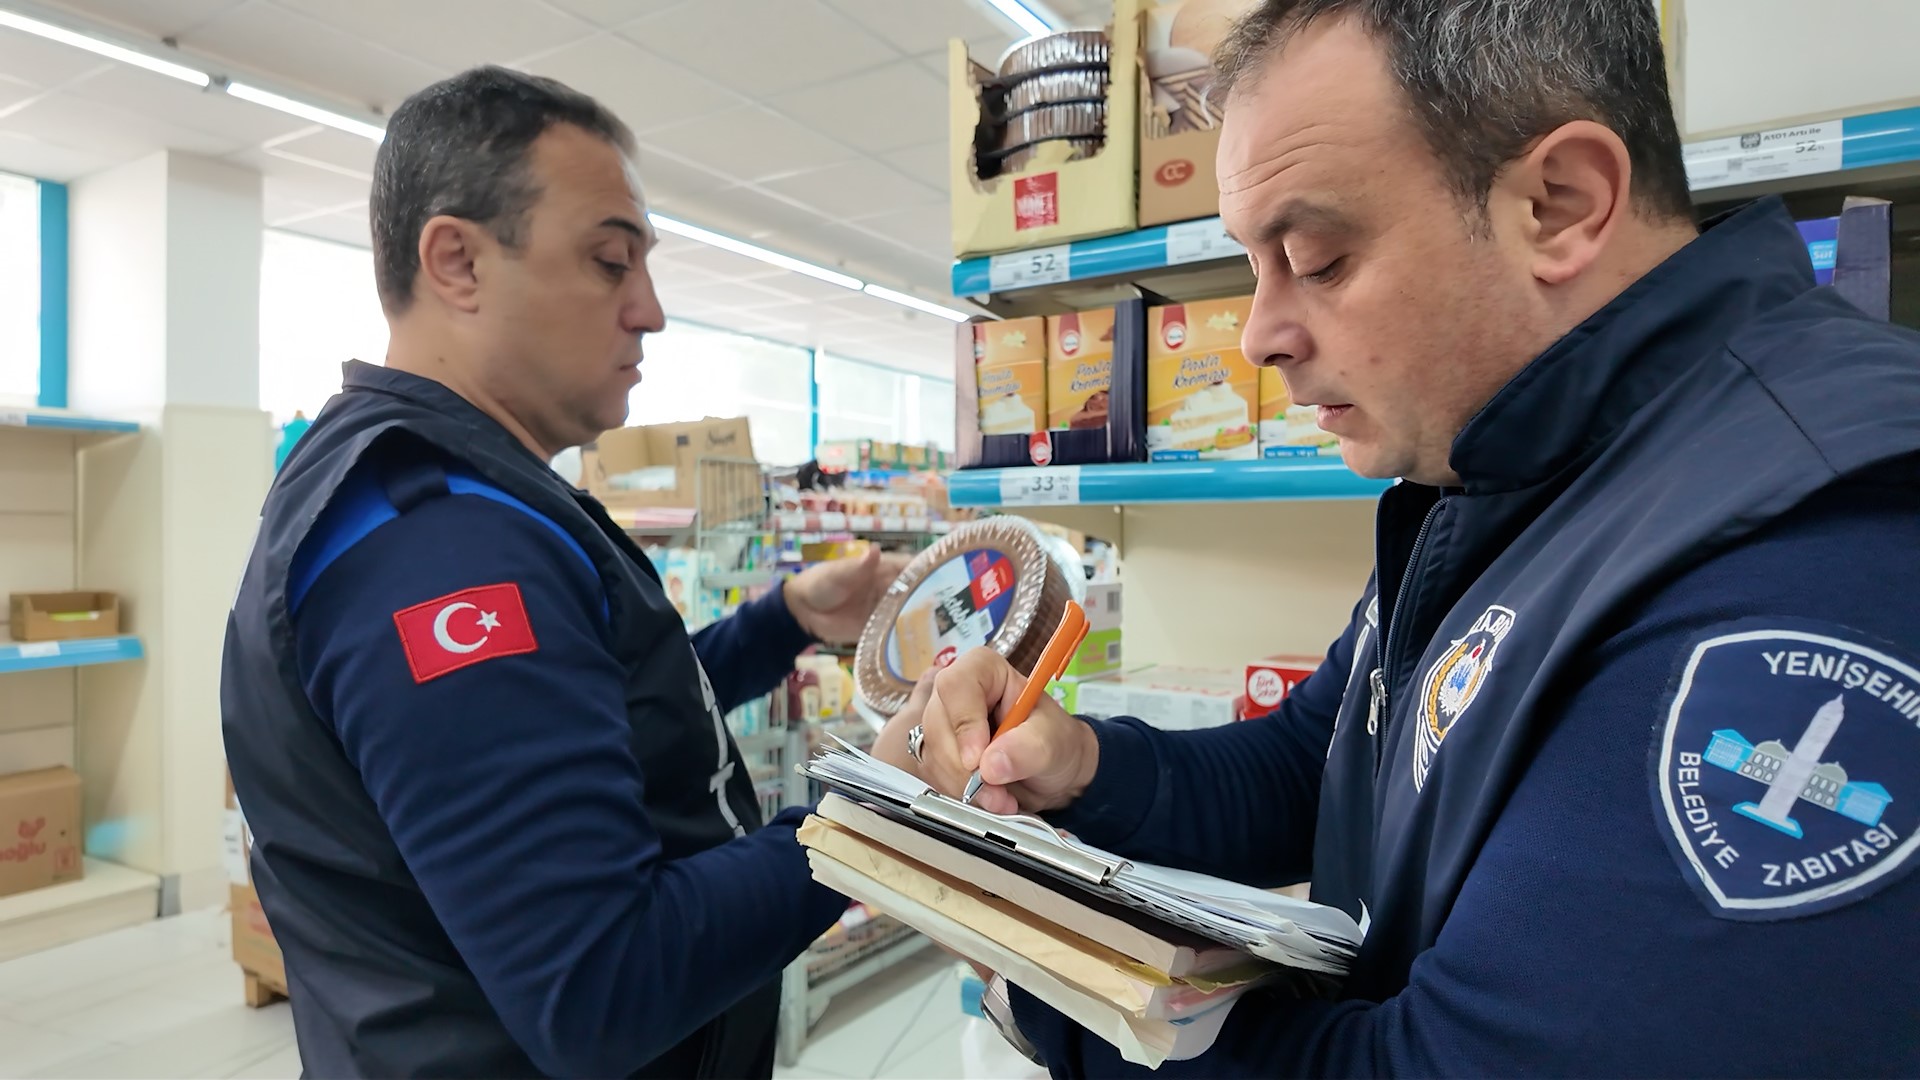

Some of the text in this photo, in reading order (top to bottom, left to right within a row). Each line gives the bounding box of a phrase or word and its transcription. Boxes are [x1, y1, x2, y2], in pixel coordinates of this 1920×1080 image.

[1763, 132, 1787, 142] A101
[1794, 139, 1818, 154] 52
[1030, 252, 1056, 274] 52
[1181, 353, 1221, 372] Pasta
[1031, 475, 1054, 492] 33
[1678, 751, 1740, 869] BELEDİYE
[1761, 822, 1899, 887] ZABITASI
